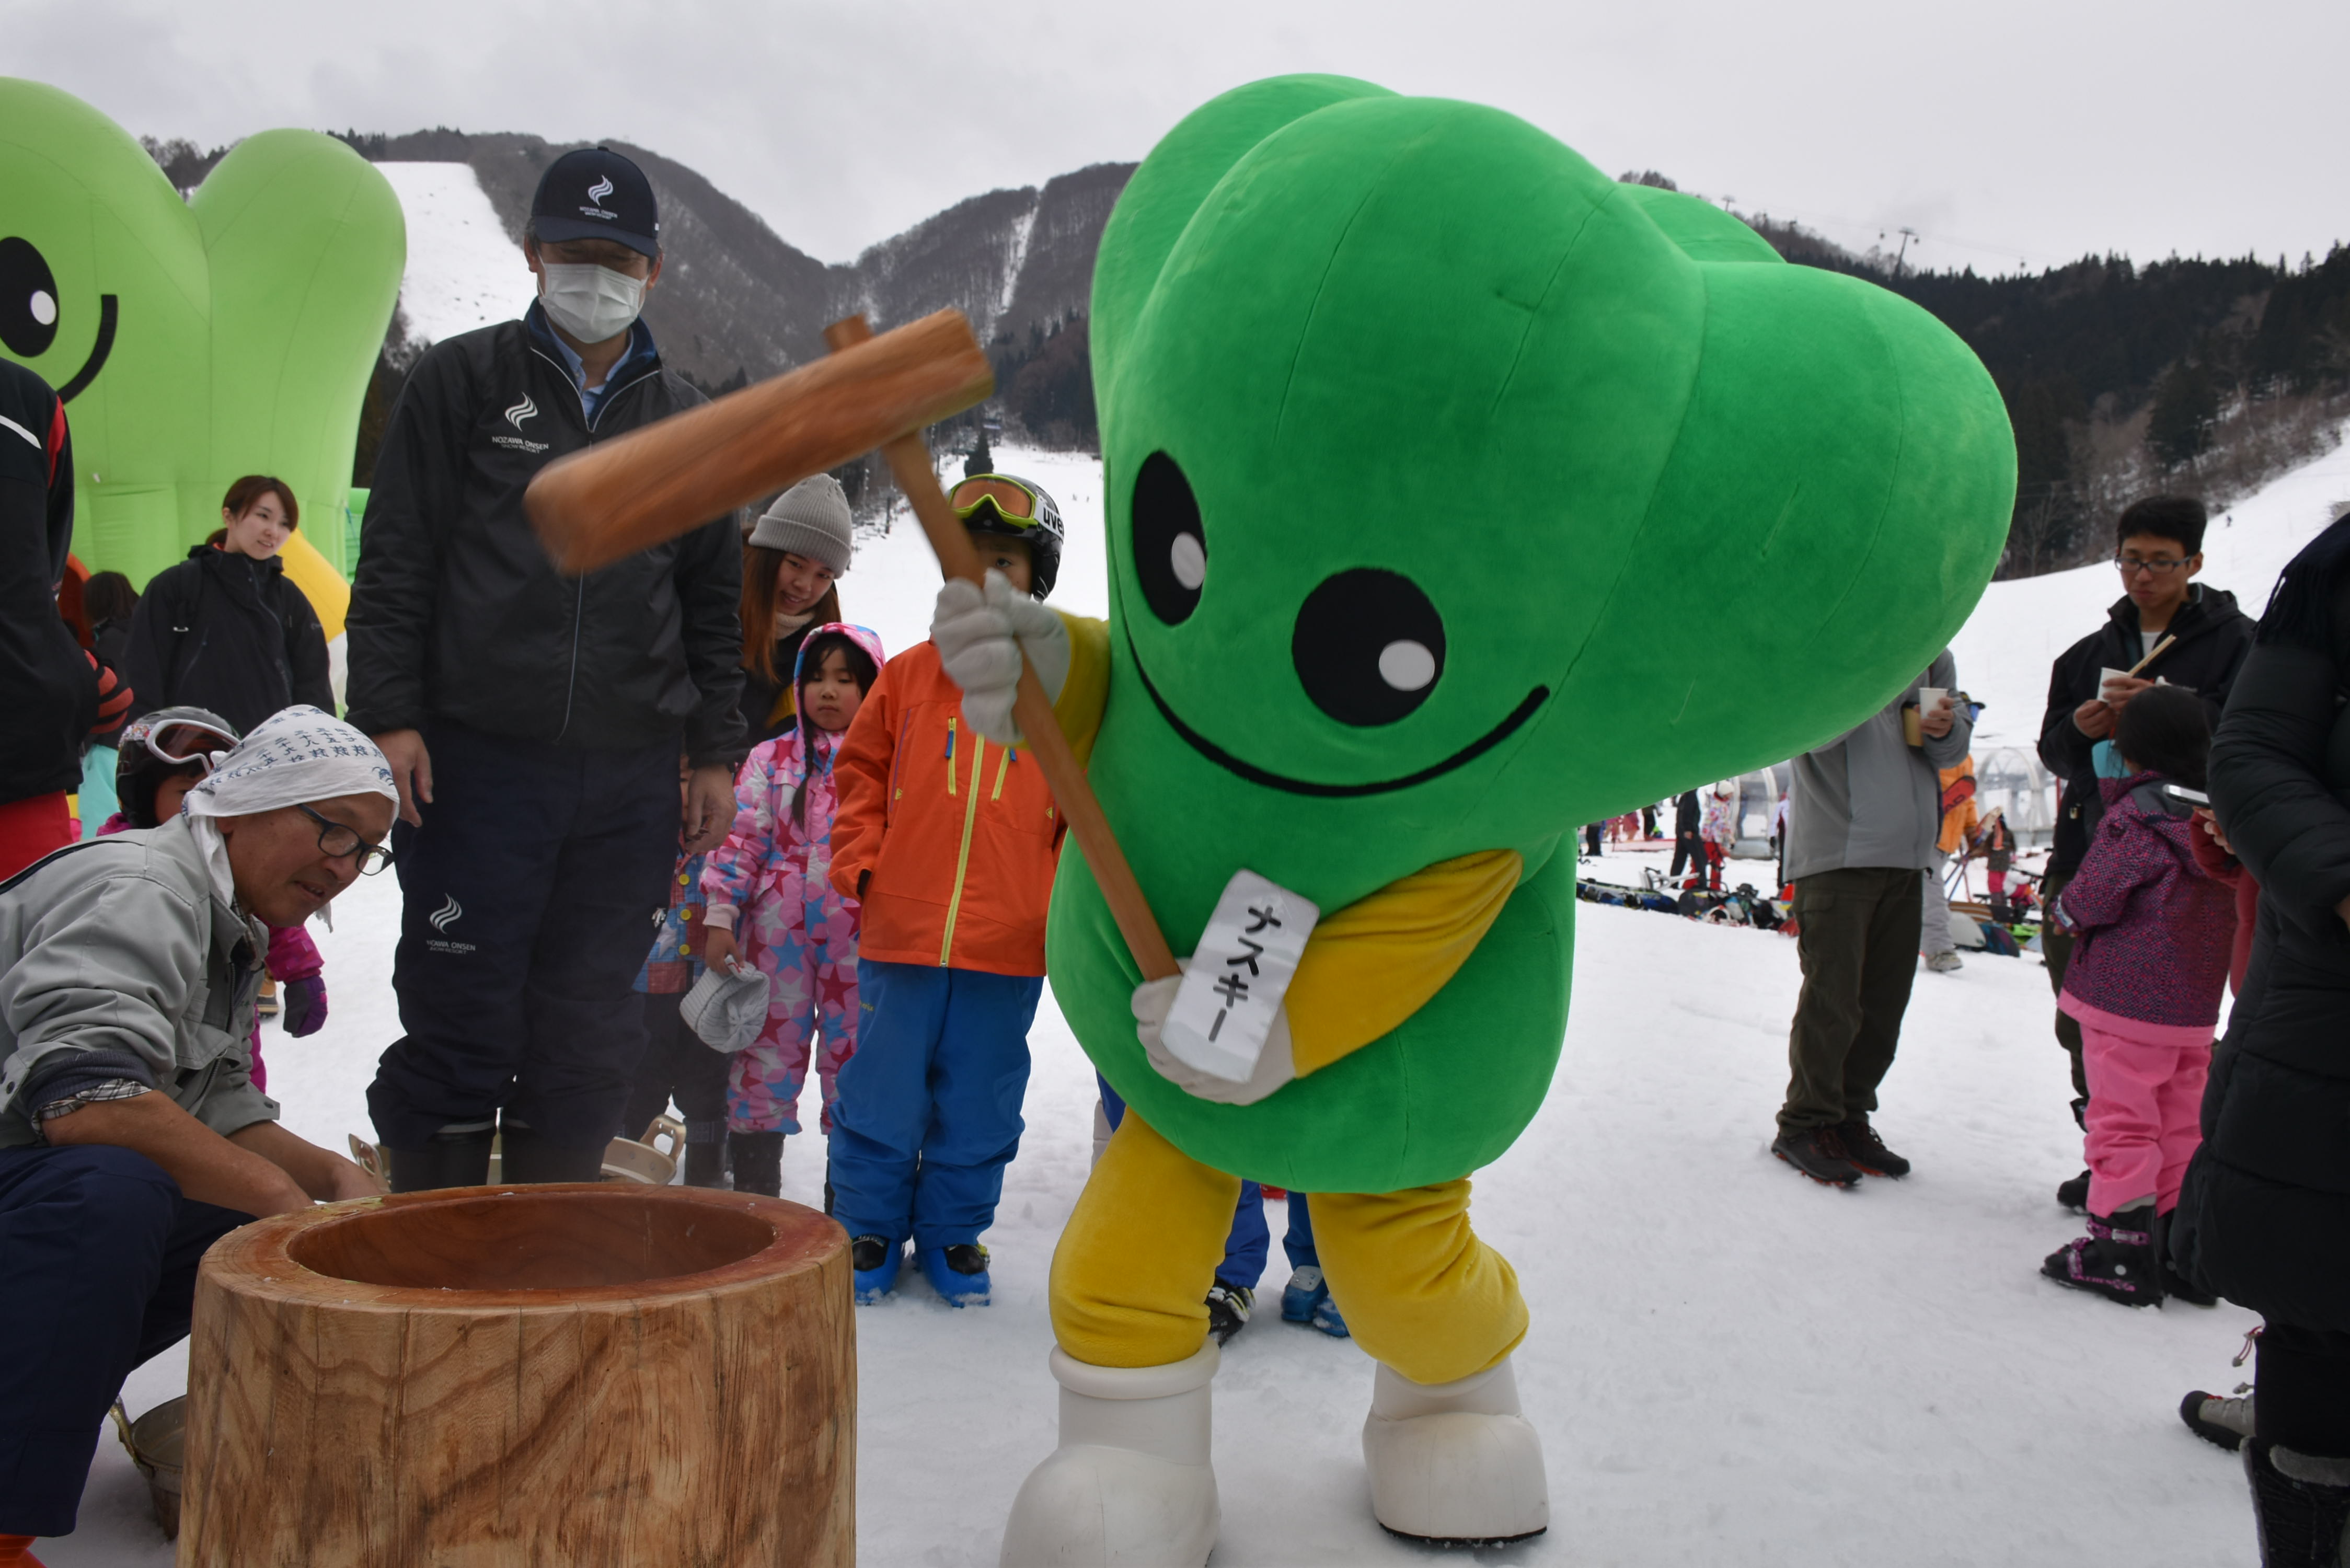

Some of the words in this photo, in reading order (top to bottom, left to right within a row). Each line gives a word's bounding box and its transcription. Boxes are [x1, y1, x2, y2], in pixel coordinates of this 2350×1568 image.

[492, 436, 524, 445] NOZAWA
[525, 440, 549, 450] ONSEN
[1043, 506, 1064, 537] uve
[451, 942, 476, 951] ONSEN
[1207, 905, 1282, 1043] ナスキー
